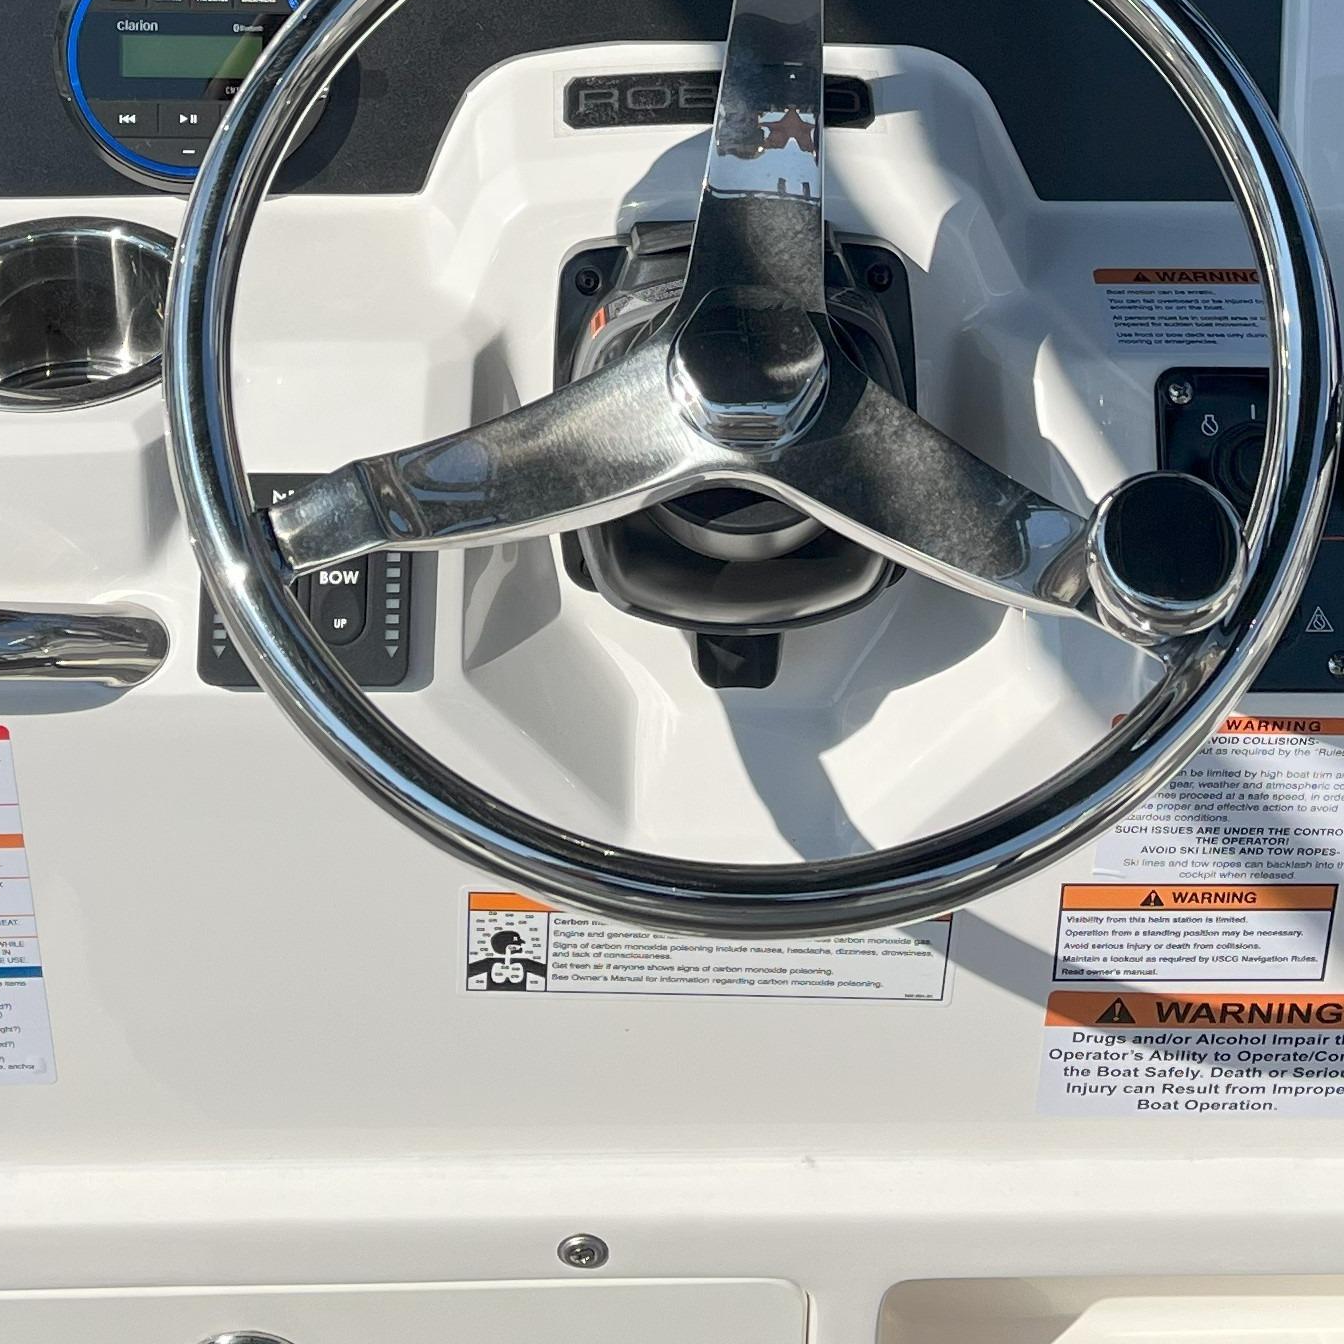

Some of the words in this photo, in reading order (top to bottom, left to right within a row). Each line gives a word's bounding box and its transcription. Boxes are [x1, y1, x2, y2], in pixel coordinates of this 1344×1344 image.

[319, 570, 360, 585] BOW
[333, 618, 348, 629] UP
[1226, 719, 1321, 732] WARNING
[1208, 736, 1240, 745] VOID
[1114, 826, 1148, 834] SUCH
[1151, 826, 1194, 834] ISSUES
[1196, 826, 1221, 835] ARE
[1224, 827, 1264, 836] UNDER
[1268, 828, 1290, 836] THE
[1196, 836, 1219, 845] THE
[1140, 846, 1177, 854] AVOID
[1180, 846, 1199, 855] SKI
[1202, 846, 1236, 855] LINES
[1238, 847, 1264, 856] AND
[1268, 848, 1294, 856] TOW
[1172, 892, 1257, 904] WARNING
[1156, 1002, 1344, 1024] WARNING
[1072, 1032, 1127, 1046] Drugs
[1132, 1032, 1192, 1045] and/or
[1196, 1034, 1266, 1046] Alcohol
[1272, 1034, 1330, 1048] Impair
[1048, 1048, 1144, 1062] Operator's
[1149, 1050, 1208, 1064] Ability
[1214, 1052, 1231, 1062] to
[1064, 1066, 1091, 1078] the
[1096, 1066, 1140, 1078] Boat
[1144, 1066, 1204, 1080] Safely.
[1210, 1067, 1262, 1078] Death
[1268, 1070, 1288, 1078] or
[1066, 1082, 1118, 1096] Injury
[1123, 1085, 1155, 1094] can
[1162, 1083, 1220, 1094] Result
[1225, 1084, 1266, 1095] from
[1137, 1099, 1180, 1111] Boat
[1184, 1100, 1278, 1113] Operation.
